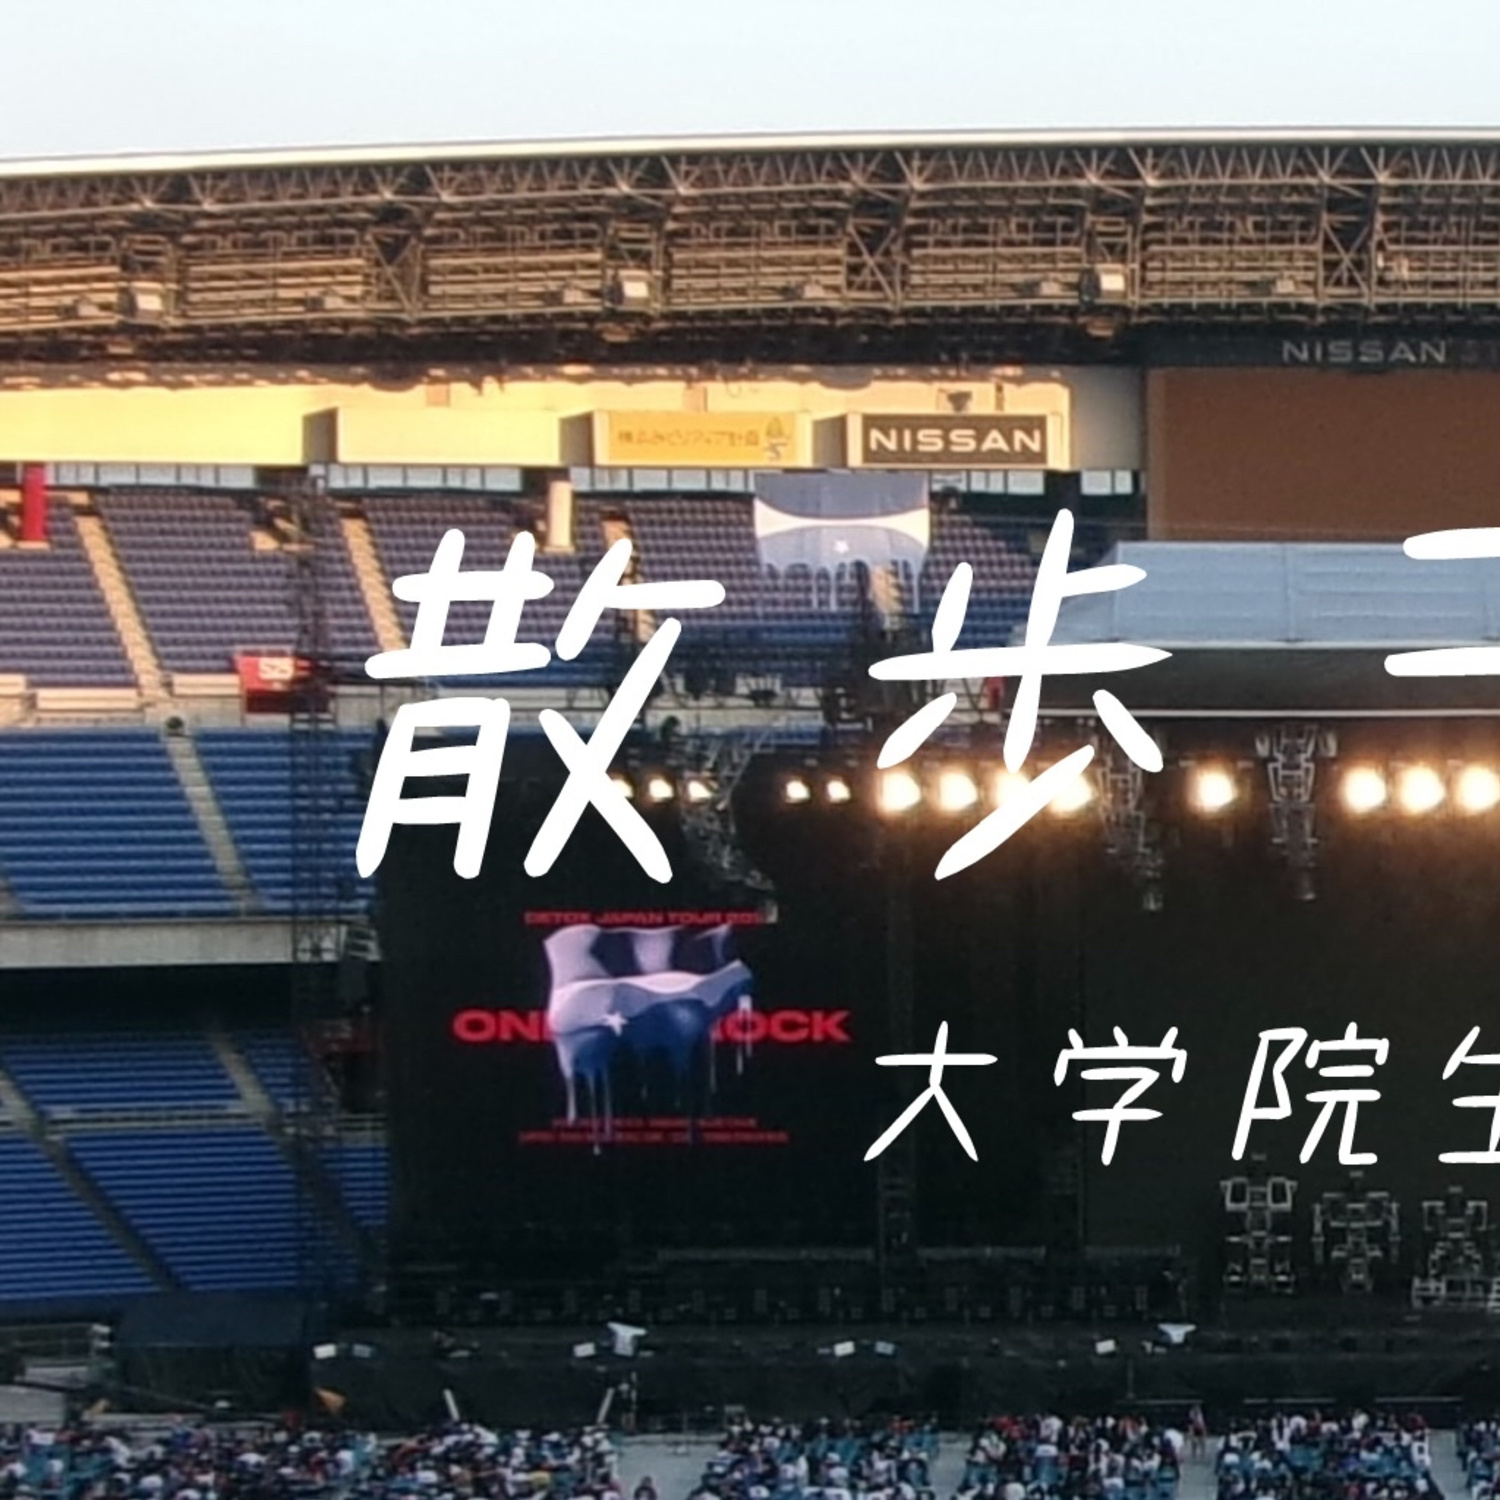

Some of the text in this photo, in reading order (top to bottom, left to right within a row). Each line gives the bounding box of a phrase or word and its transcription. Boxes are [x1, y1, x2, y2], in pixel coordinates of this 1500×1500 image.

[1282, 340, 1447, 364] NISSAN
[869, 427, 1042, 452] NISSAN
[597, 911, 664, 925] JAPAN
[667, 911, 721, 925] TOUR
